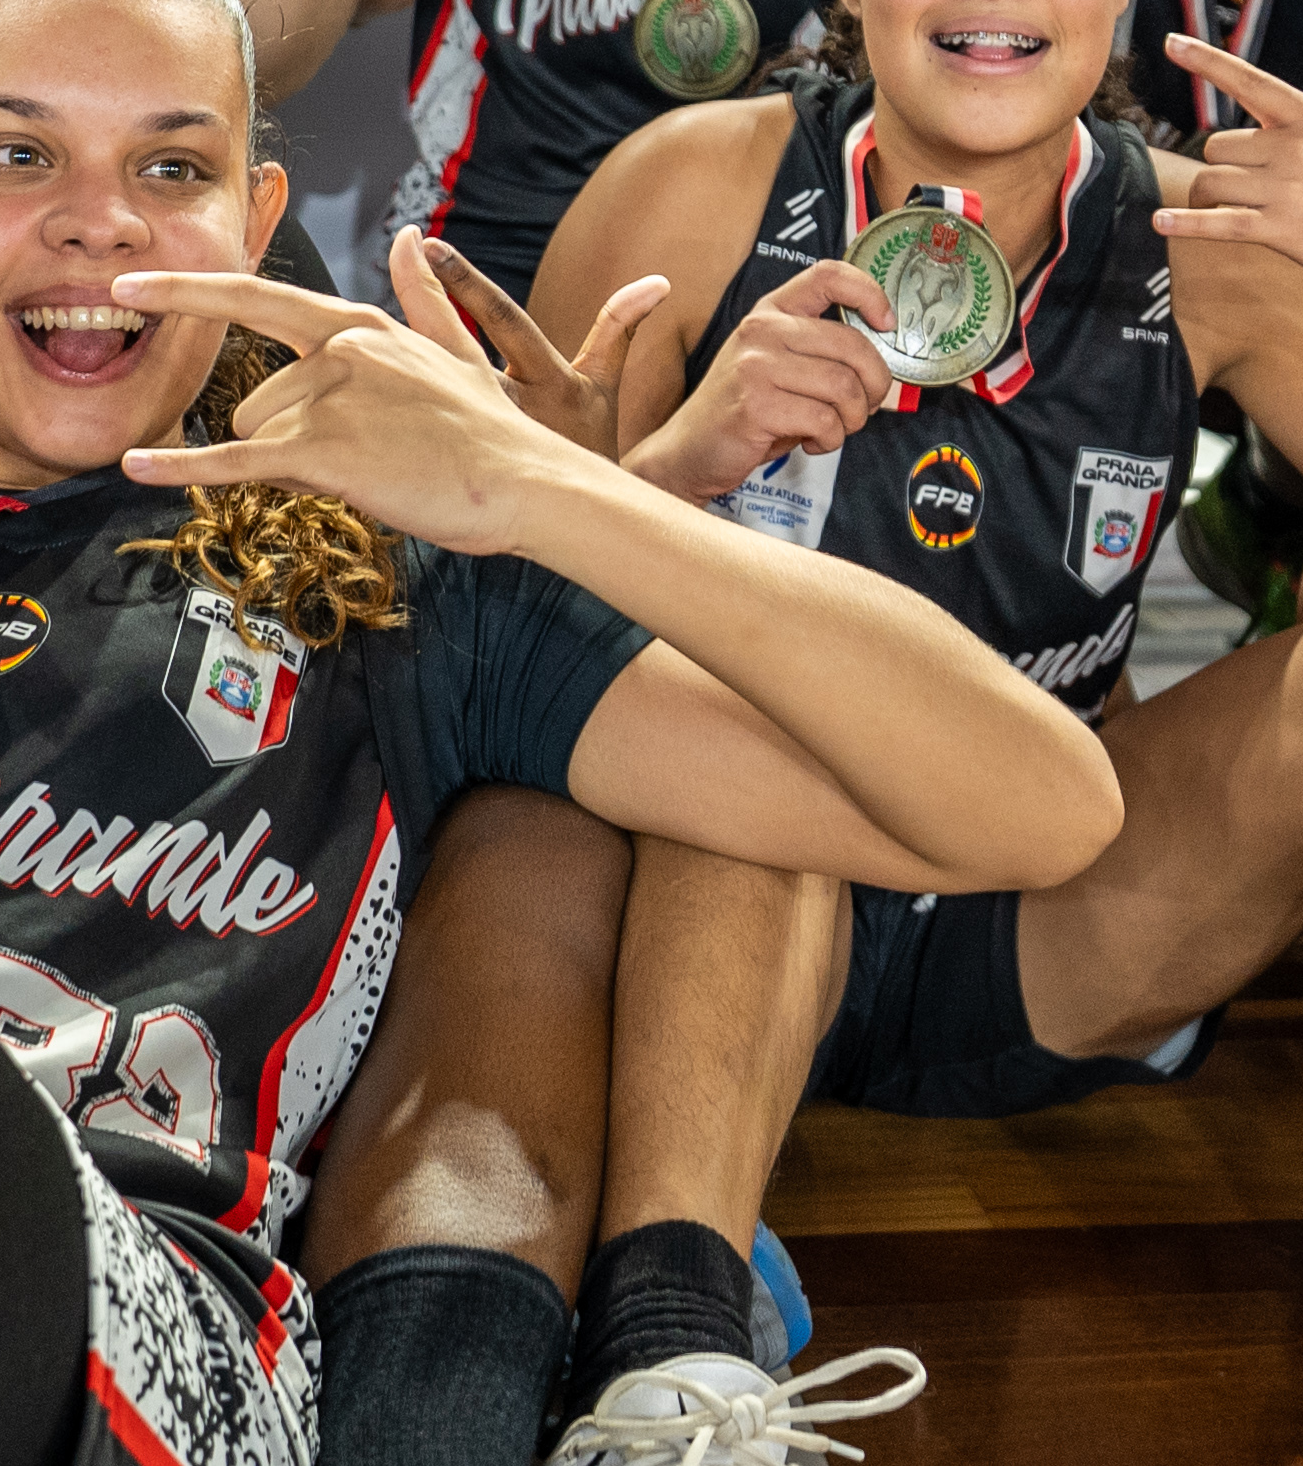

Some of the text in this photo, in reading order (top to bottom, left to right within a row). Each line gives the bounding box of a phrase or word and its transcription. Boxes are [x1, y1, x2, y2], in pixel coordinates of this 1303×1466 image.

[1082, 468, 1164, 489] GRANDE
[1097, 457, 1155, 476] PRAIA
[761, 485, 774, 497] DE
[775, 488, 814, 509] ATLETAS
[915, 483, 976, 516] FPB
[194, 604, 298, 668] GRDE
[214, 598, 286, 646] PAIA
